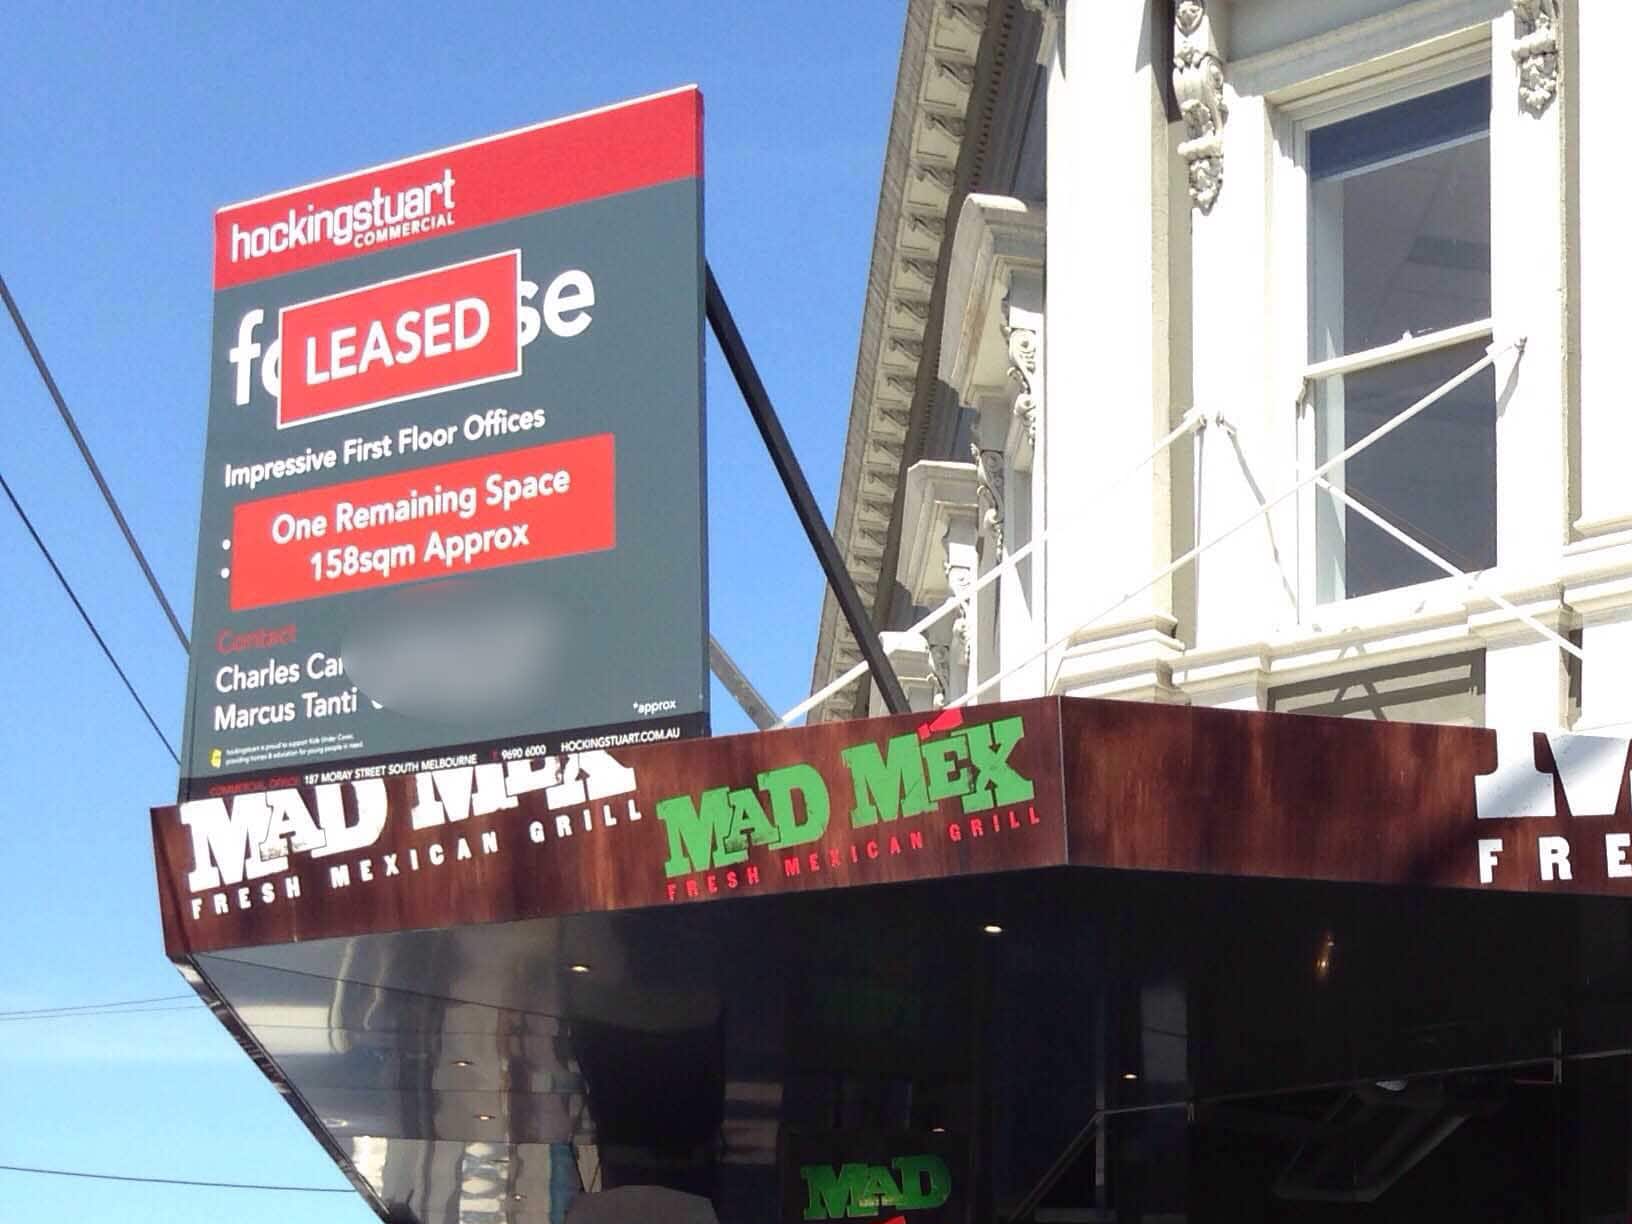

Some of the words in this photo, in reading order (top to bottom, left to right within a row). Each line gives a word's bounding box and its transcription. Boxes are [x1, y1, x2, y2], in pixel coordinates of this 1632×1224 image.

[231, 169, 456, 262] hockingstuart
[353, 214, 455, 249] COMMERCIAL
[305, 297, 490, 385] LEASED
[225, 448, 337, 488] Impressive
[343, 436, 392, 464] First
[398, 425, 458, 454] Floor
[463, 408, 546, 441] Offices
[272, 512, 326, 546] One
[336, 486, 477, 533] Remaining
[485, 470, 570, 511] Space
[309, 544, 416, 582] 158sqm
[423, 523, 529, 565] Approx
[215, 702, 296, 731] Marcus
[302, 687, 358, 718] Tanti
[216, 658, 300, 693] Charles
[304, 774, 319, 786] 187
[321, 770, 352, 783] MORAY
[355, 766, 386, 779] STREET
[388, 762, 420, 775] SOUTH
[421, 754, 478, 772] MELBOURNE
[501, 747, 523, 760] 9690
[524, 744, 546, 757] 6000
[561, 727, 681, 752] HOCKINGSTUART.COM.AU
[656, 763, 830, 878] MAD
[841, 715, 1035, 830] MEX
[178, 775, 388, 893] MAD
[191, 875, 302, 920] FRESH
[331, 829, 500, 889] MEXICAN
[529, 799, 642, 843] GRILL
[665, 865, 760, 901] FRESH
[784, 831, 923, 877] MEXICAN
[949, 807, 1041, 842] GRILL
[802, 1154, 952, 1221] MAD
